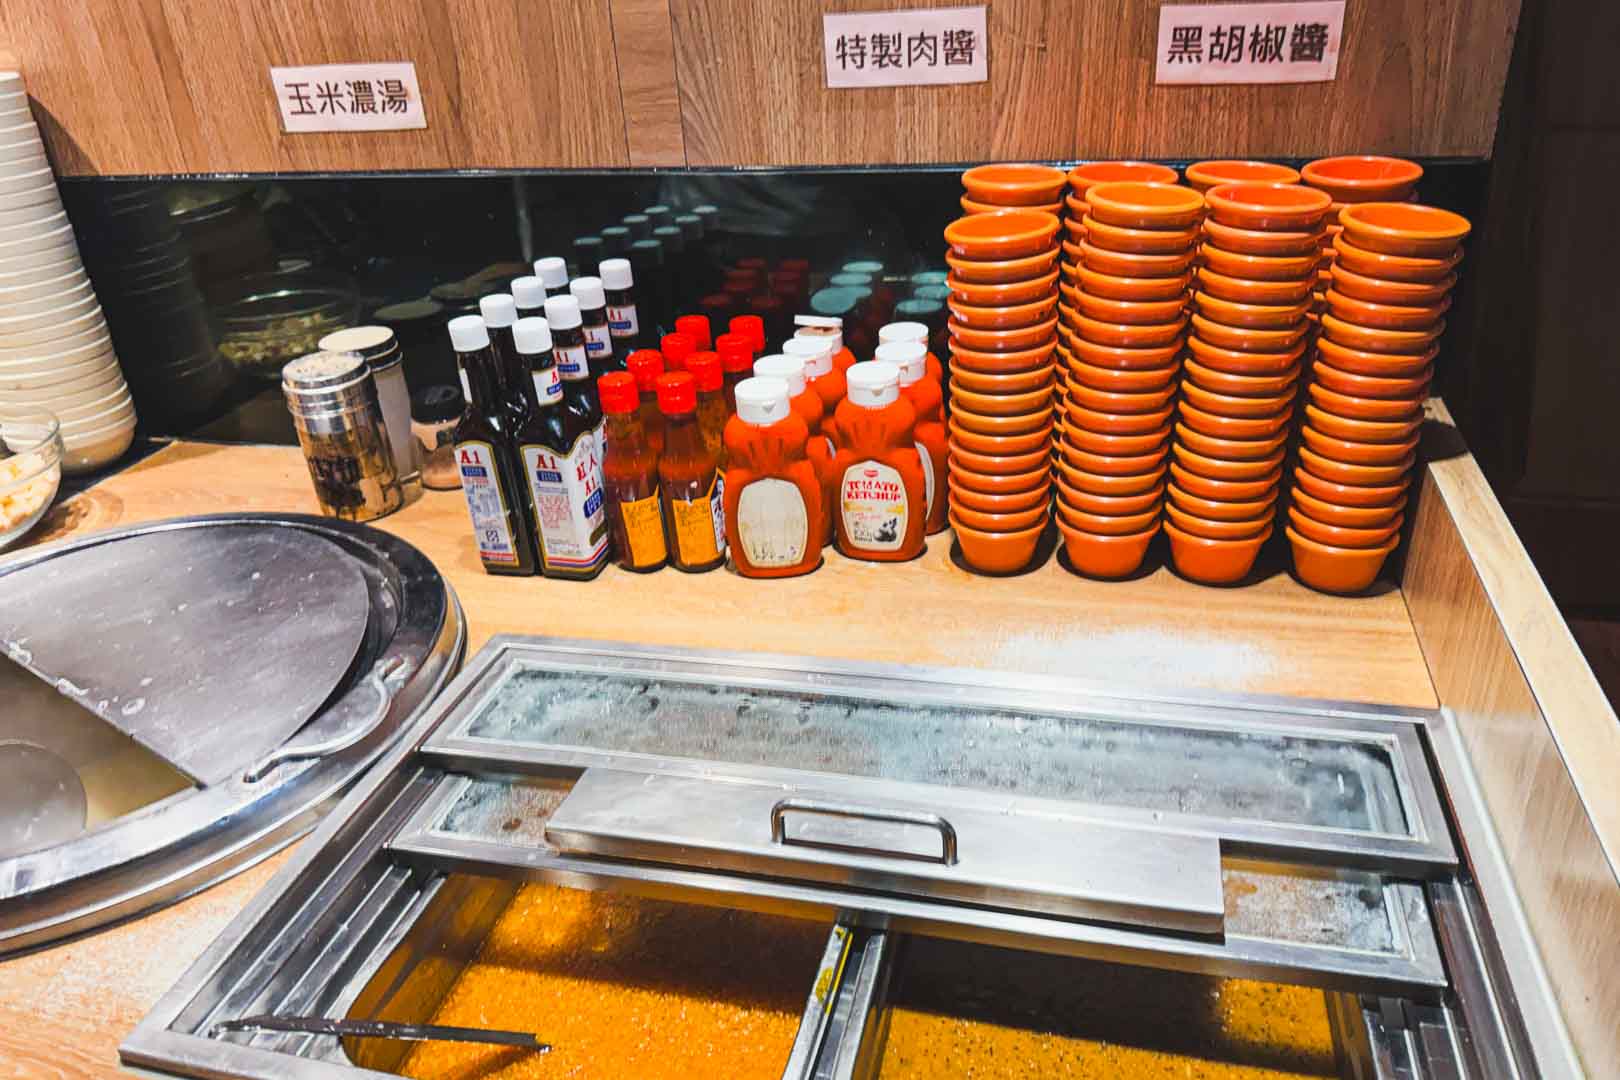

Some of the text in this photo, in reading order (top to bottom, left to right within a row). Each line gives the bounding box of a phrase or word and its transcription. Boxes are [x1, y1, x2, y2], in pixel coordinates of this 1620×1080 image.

[835, 28, 976, 71] 特製肉醬
[1167, 22, 1329, 65] 黑胡椒醬
[284, 79, 408, 116] 玉米濃湯
[460, 450, 482, 465] A1
[536, 453, 558, 470] A1
[847, 480, 899, 493] TOMATO
[846, 490, 902, 502] KETCHUP
